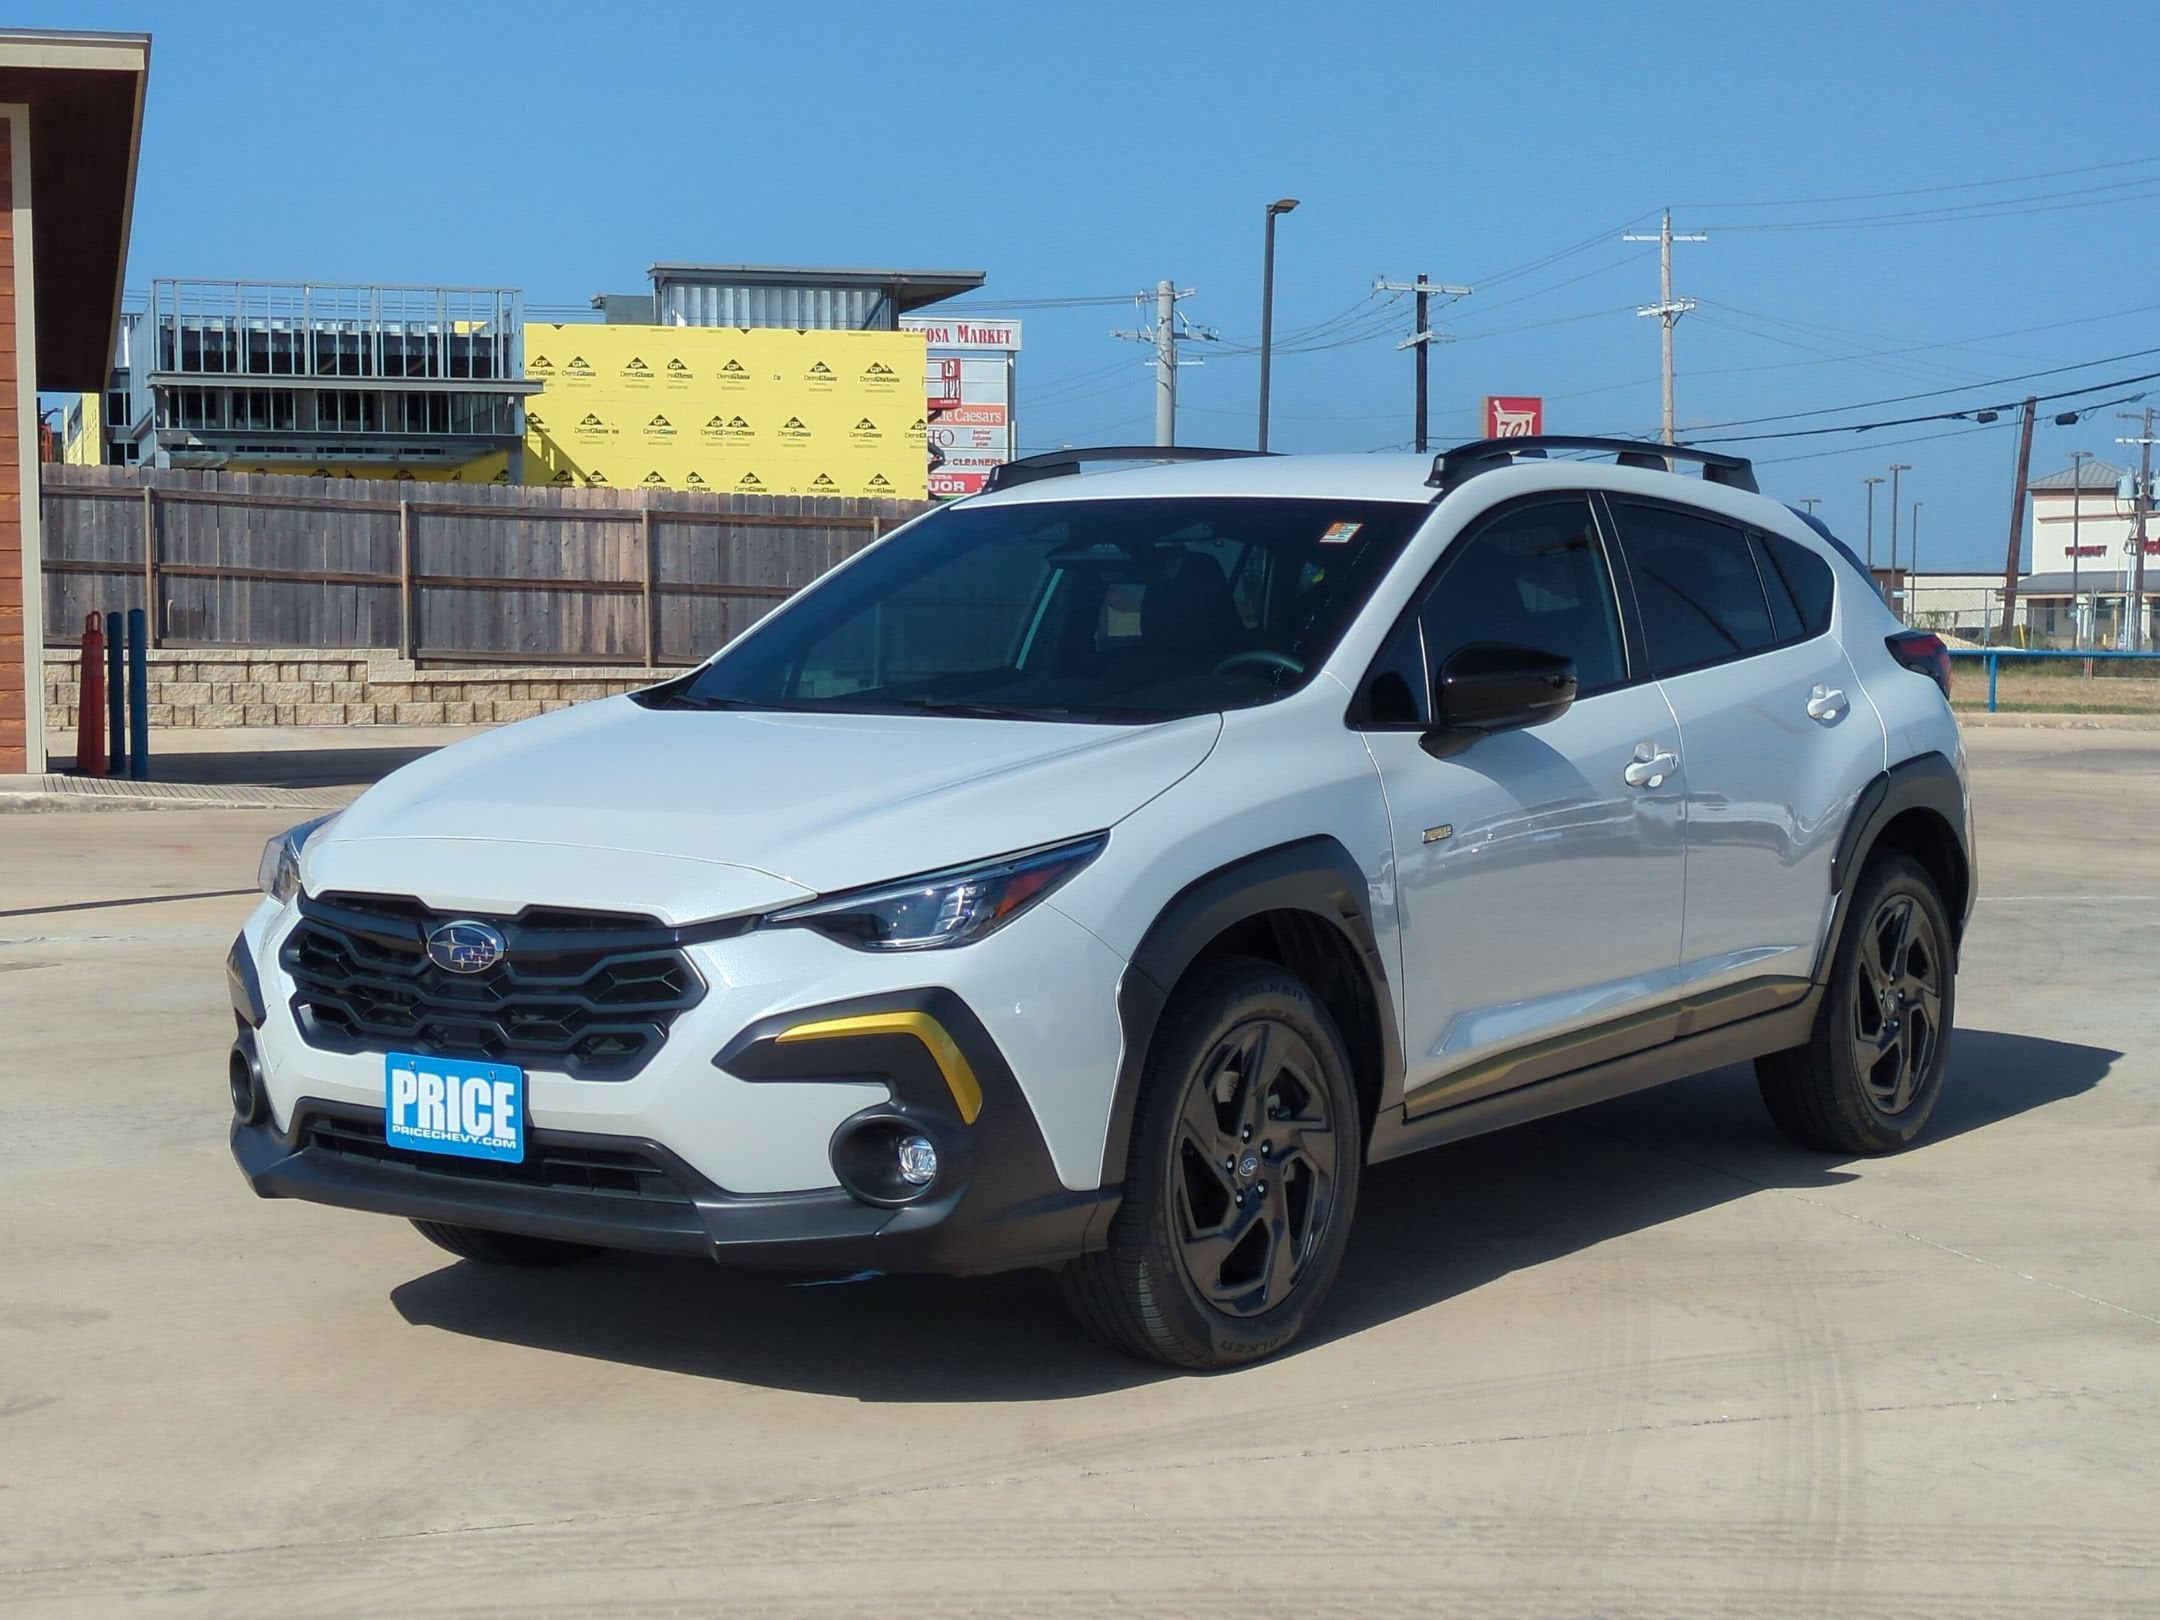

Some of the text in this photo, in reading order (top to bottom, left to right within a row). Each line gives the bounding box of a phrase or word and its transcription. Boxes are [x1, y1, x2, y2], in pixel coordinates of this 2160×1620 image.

[957, 324, 1011, 345] MARKET
[954, 408, 1002, 422] Caesars
[952, 458, 1004, 466] CLEANERS
[391, 1068, 516, 1140] PRICE
[392, 1124, 517, 1149] PRICECHEVY.COM
